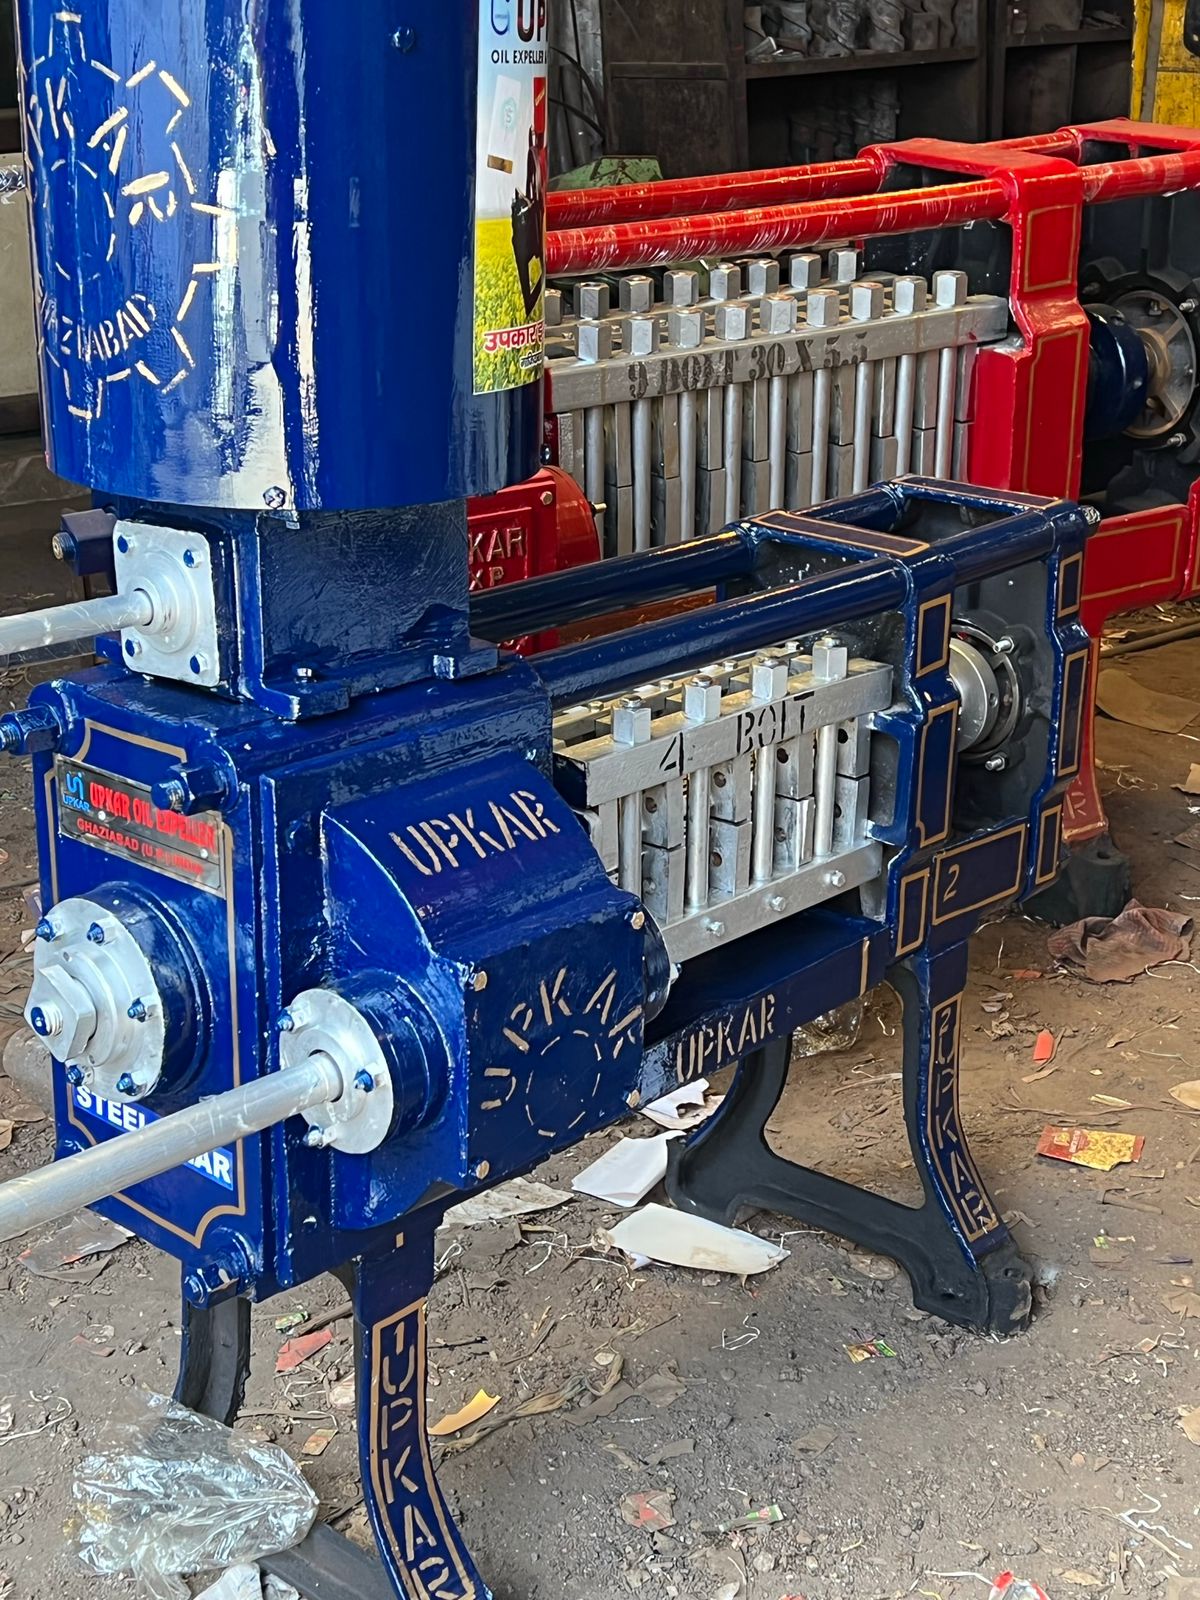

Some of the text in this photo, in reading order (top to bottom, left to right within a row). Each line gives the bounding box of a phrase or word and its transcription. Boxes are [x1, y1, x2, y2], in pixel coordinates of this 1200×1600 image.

[517, 0, 548, 43] UP
[491, 49, 510, 64] OIL
[628, 361, 648, 398] 9
[750, 342, 786, 380] 30
[659, 691, 815, 776] 4 BOLT
[62, 793, 91, 813] UPKAR
[89, 782, 131, 822] UPKAR
[132, 797, 154, 829] OIL
[76, 817, 139, 851] GHAZIABAD
[388, 790, 561, 876] UPKAR
[943, 863, 960, 903] 2
[676, 993, 775, 1083] UPKAR
[939, 1008, 951, 1036] 2
[935, 1036, 990, 1234] UPKAR
[381, 1344, 461, 1600] UPKAR
